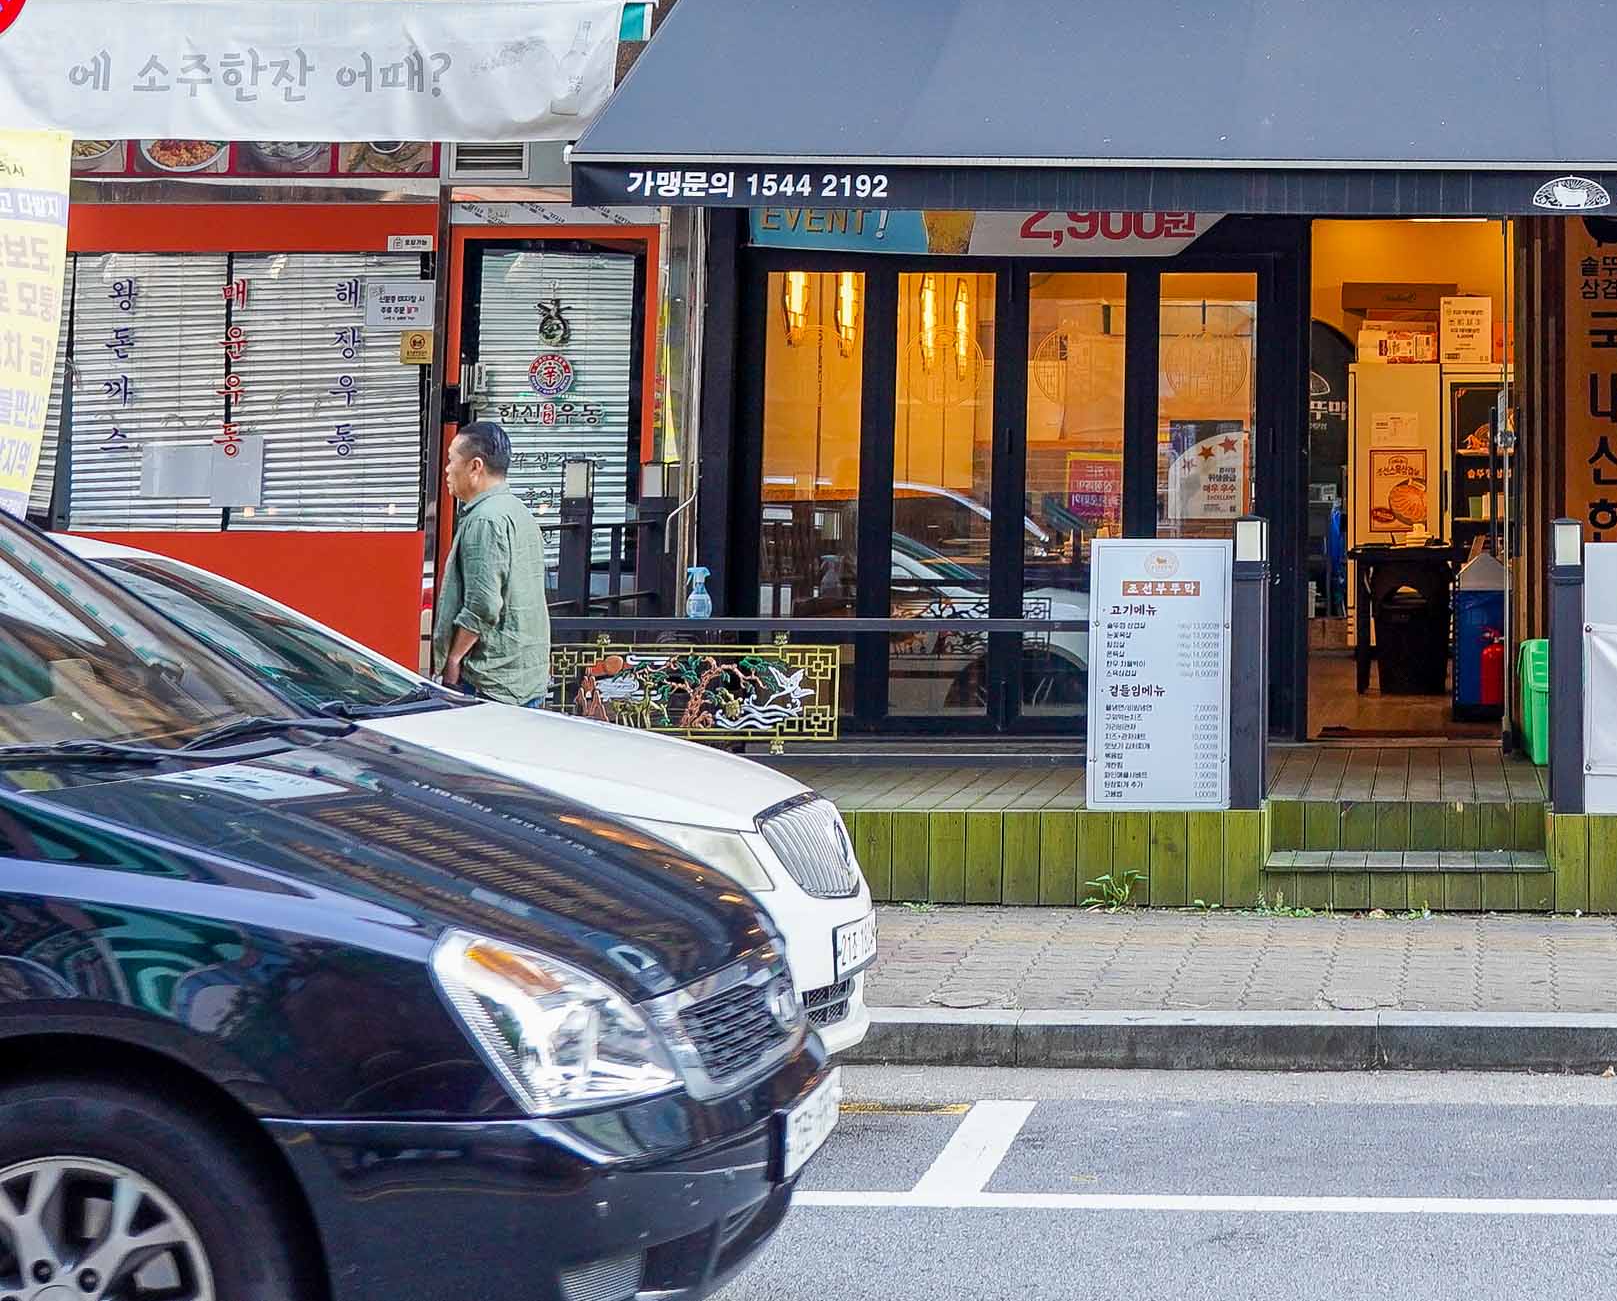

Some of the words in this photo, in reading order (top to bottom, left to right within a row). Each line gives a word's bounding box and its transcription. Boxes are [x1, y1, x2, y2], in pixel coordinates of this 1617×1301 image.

[132, 46, 317, 103] 소주한잔
[335, 48, 453, 99] 어때?
[626, 171, 735, 198] 가맹문의
[746, 174, 812, 197] 1544
[820, 174, 889, 198] 2192
[99, 277, 138, 452] 왕돈까스
[212, 277, 250, 458] 매운우동
[326, 279, 363, 458] 해장우동
[556, 403, 603, 425] 우동
